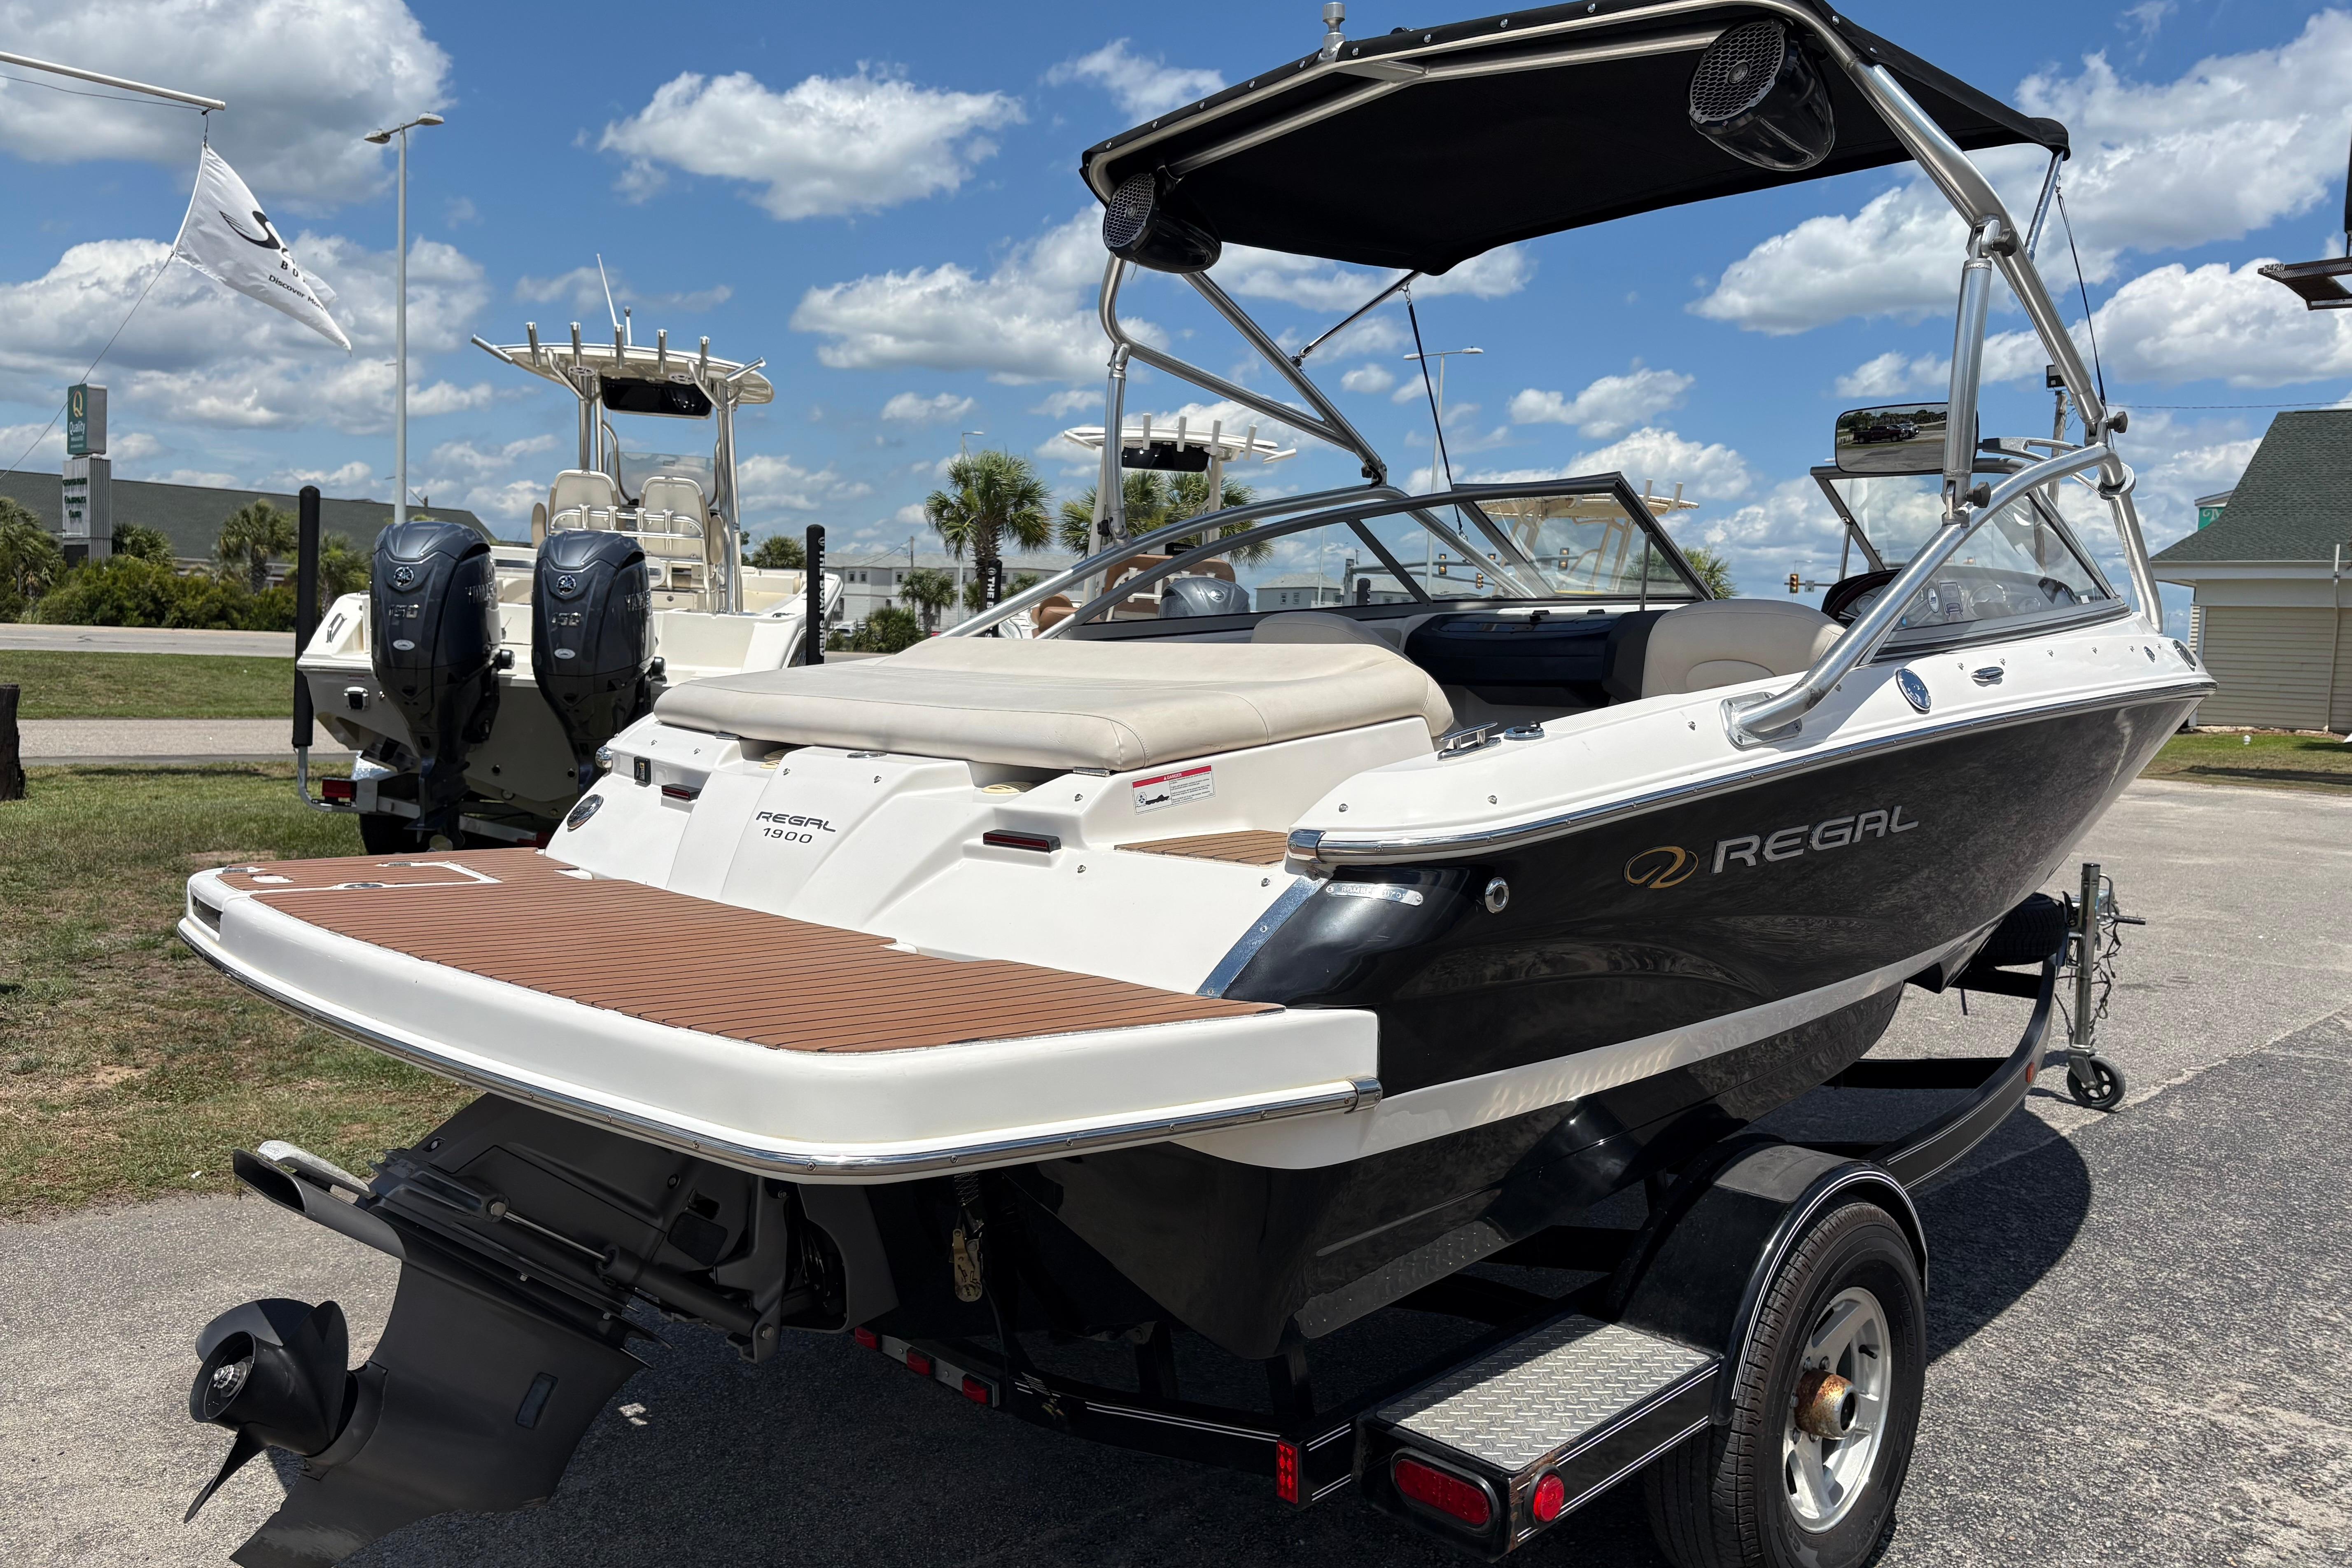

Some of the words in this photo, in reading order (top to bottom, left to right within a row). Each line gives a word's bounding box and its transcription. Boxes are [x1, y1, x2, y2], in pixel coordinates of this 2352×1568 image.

[2264, 264, 2284, 272] 3420
[268, 275, 306, 298] Discover
[69, 421, 85, 436] Quality
[987, 577, 995, 599] THE
[389, 604, 419, 618] 150
[551, 612, 581, 626] 150
[756, 811, 836, 833] REGAL
[763, 828, 813, 843] 1900
[1711, 805, 1919, 875] REGAL
